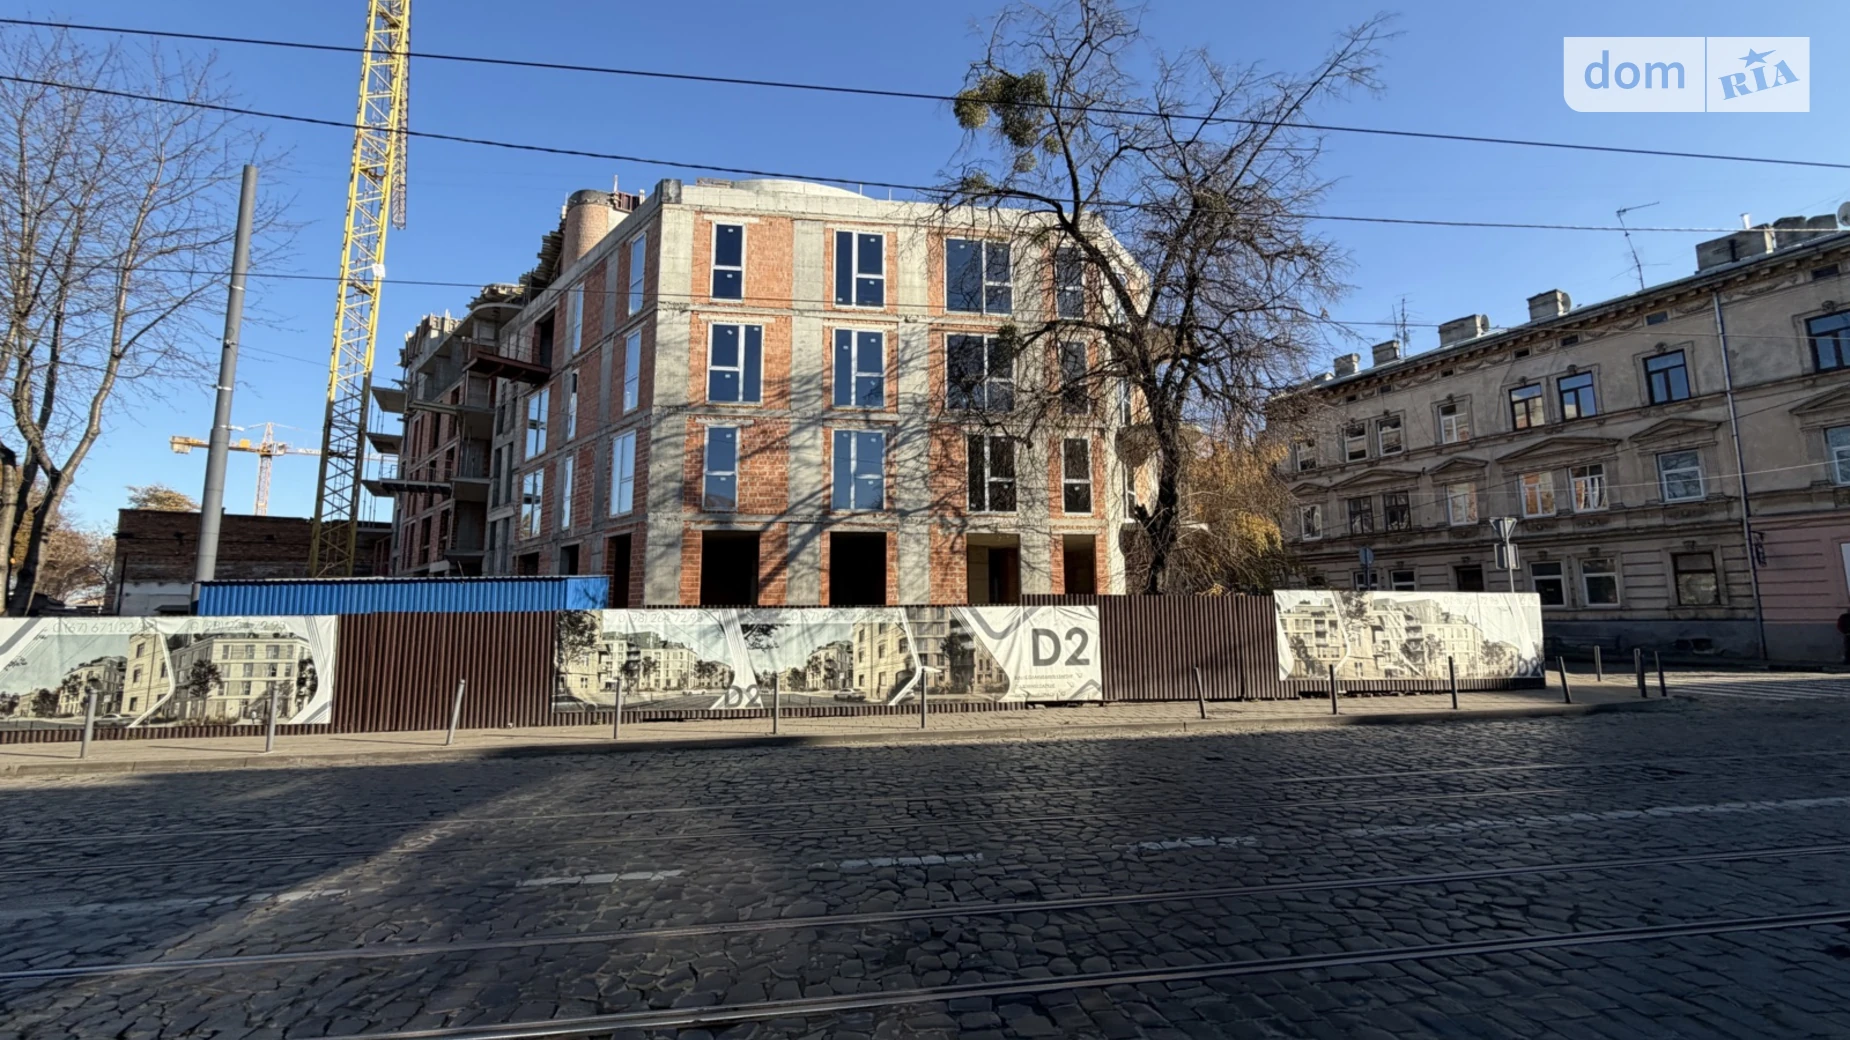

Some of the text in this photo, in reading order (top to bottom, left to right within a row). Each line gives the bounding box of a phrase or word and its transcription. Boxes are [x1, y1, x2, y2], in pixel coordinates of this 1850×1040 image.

[91, 622, 113, 633] 671
[1032, 626, 1090, 667] D2
[724, 684, 761, 708] D2
